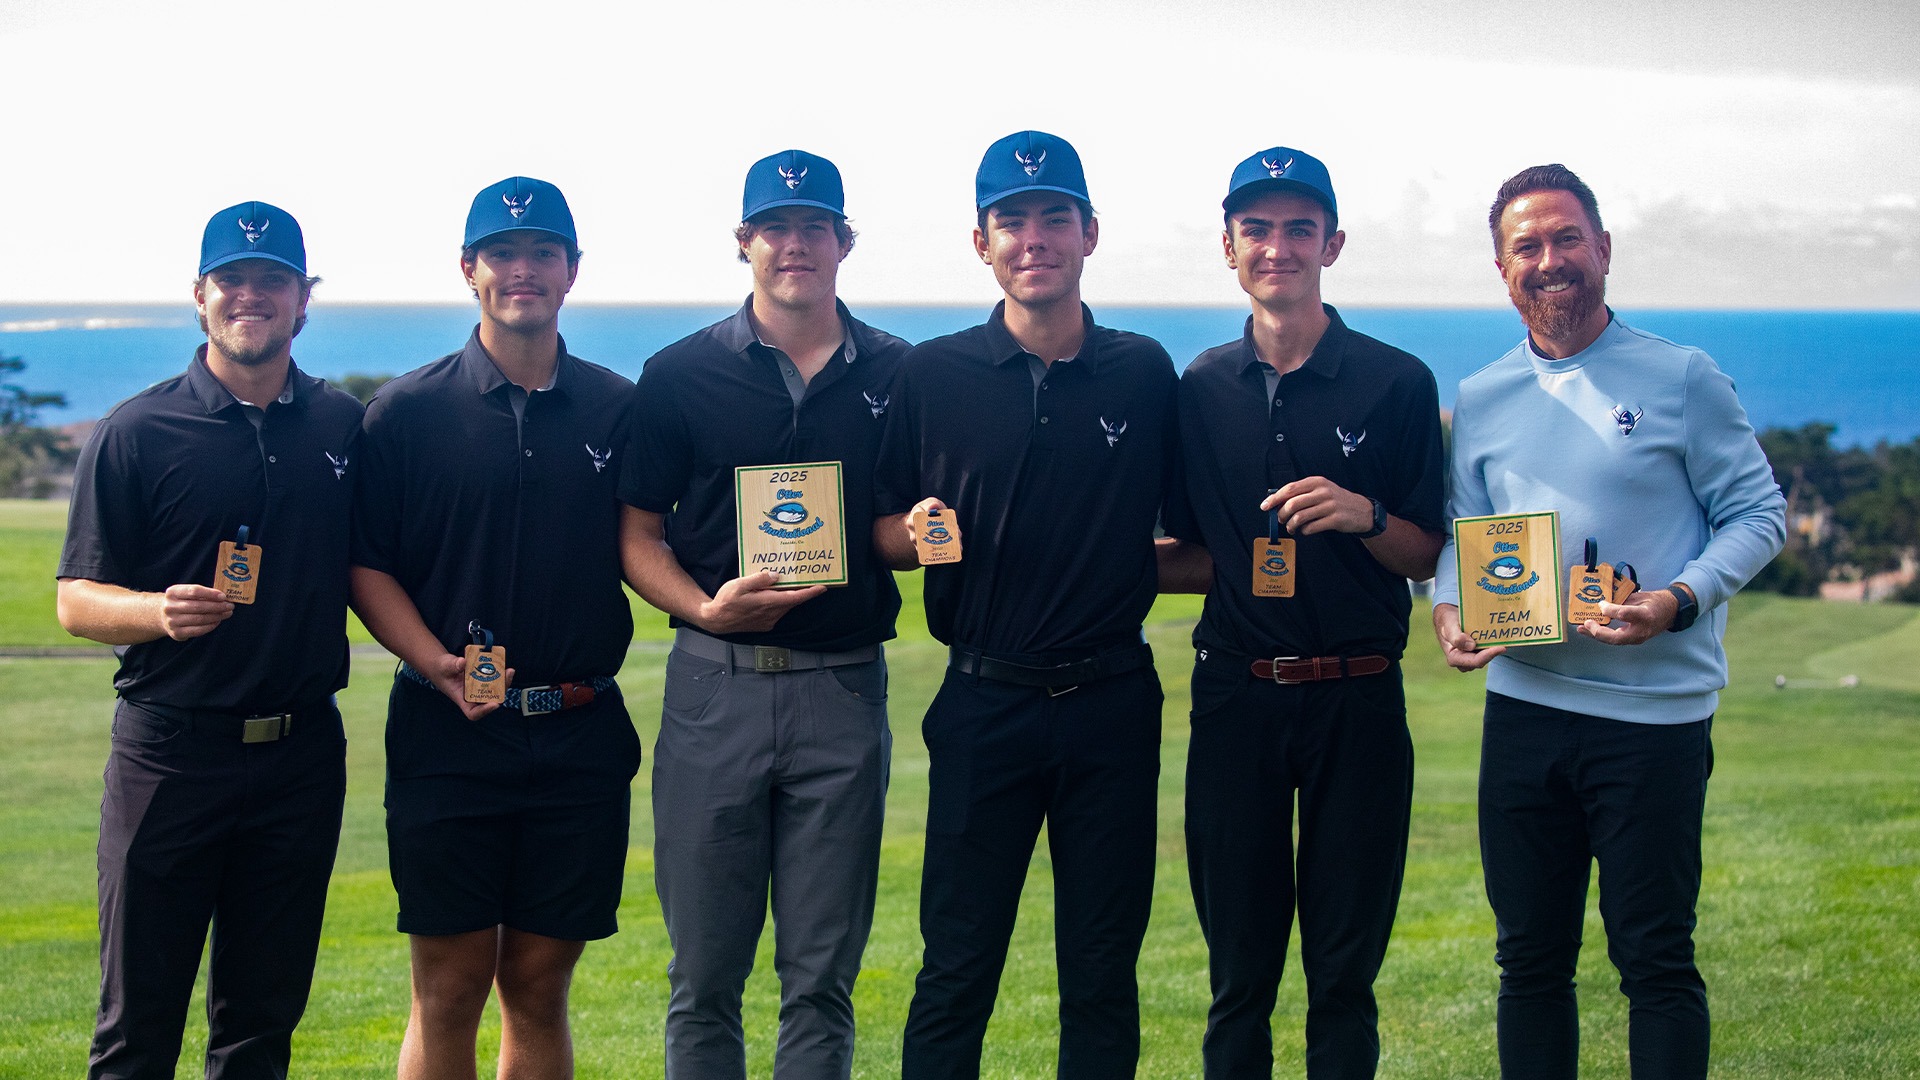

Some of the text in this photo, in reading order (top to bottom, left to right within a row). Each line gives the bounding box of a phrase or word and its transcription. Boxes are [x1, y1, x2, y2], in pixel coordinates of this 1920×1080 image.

[770, 471, 808, 483] 2025
[777, 489, 803, 500] Otter
[758, 516, 824, 539] Invitational
[1486, 521, 1523, 536] 2025
[1493, 541, 1519, 553] Otter
[752, 549, 835, 564] INDIVIDUAL
[1476, 571, 1540, 595] Invitational
[1489, 610, 1531, 624] TEAM
[1470, 625, 1552, 641] CHAMPIONS
